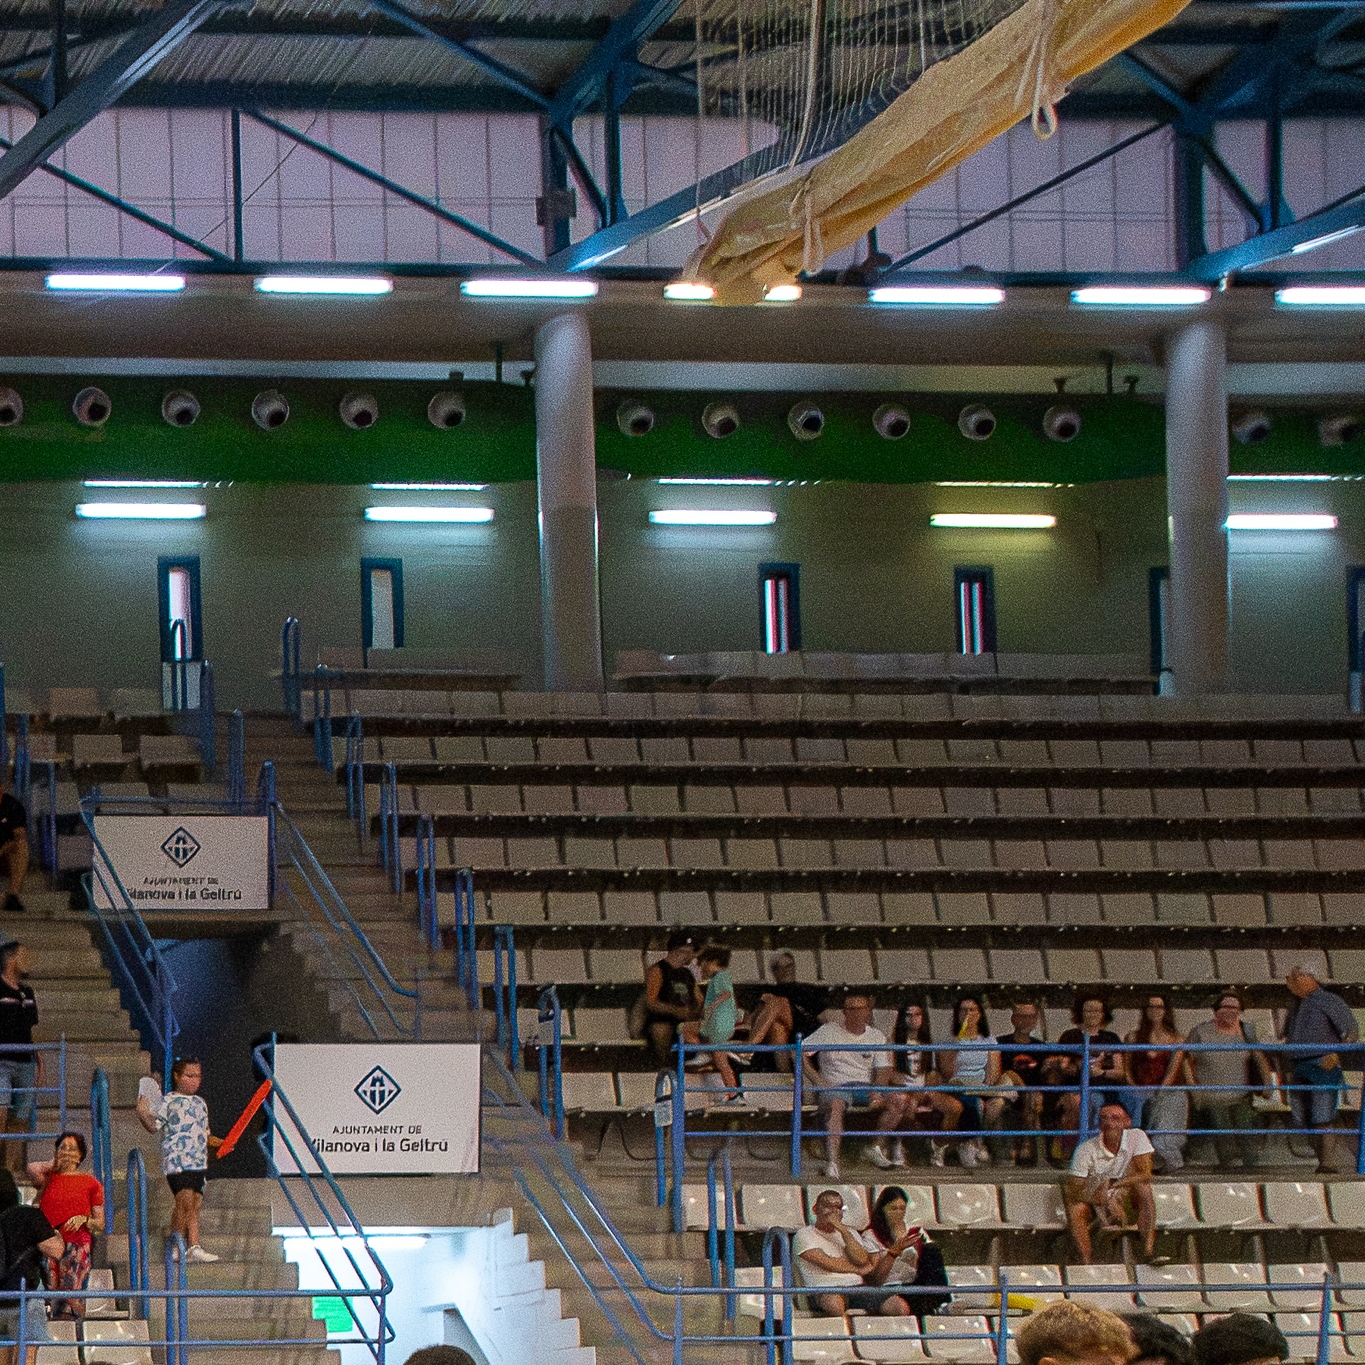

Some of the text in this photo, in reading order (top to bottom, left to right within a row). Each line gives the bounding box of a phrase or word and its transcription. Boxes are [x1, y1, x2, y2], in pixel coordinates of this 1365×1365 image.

[124, 889, 175, 900] ilanova
[200, 888, 242, 900] Geltrú
[332, 1125, 422, 1135] AJUNTAMENT DE
[382, 1138, 395, 1151] la
[399, 1138, 448, 1151] Geltrú
